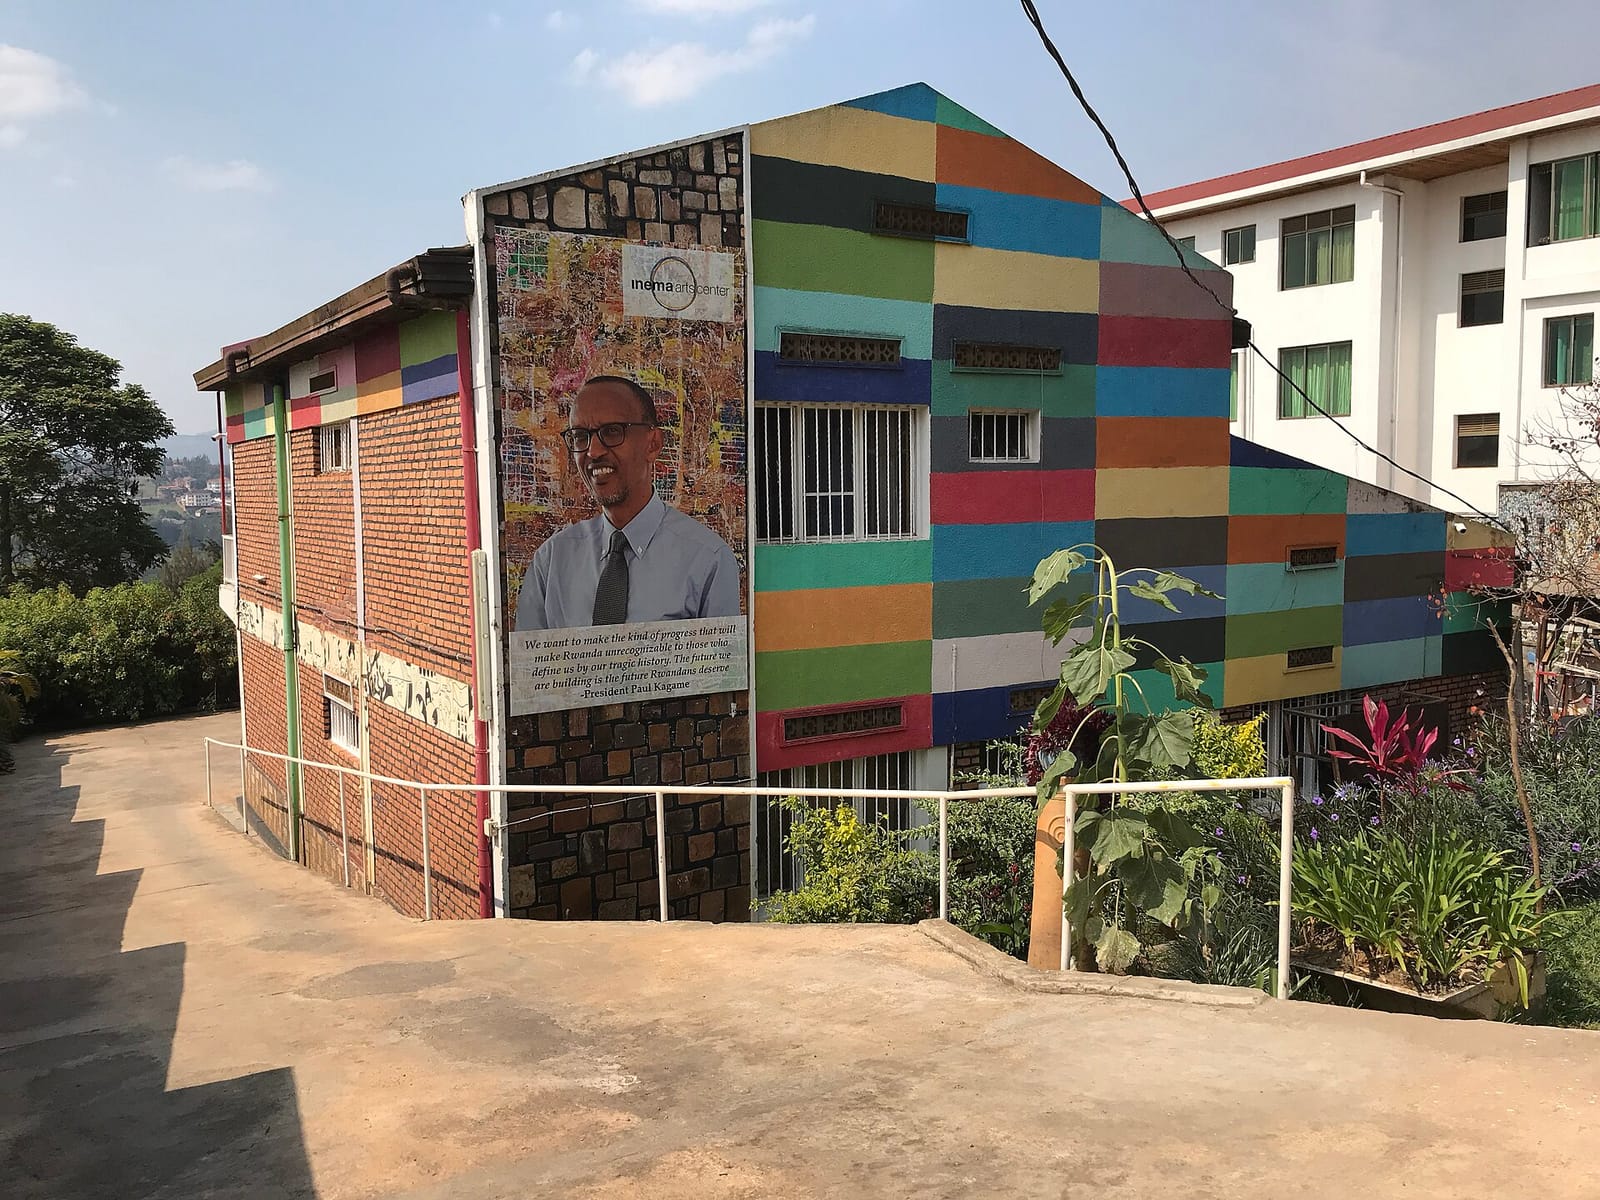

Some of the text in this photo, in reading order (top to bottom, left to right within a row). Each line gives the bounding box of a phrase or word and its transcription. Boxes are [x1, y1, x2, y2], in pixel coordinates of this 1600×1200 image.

[675, 282, 695, 294] arts
[696, 285, 730, 296] center
[525, 625, 736, 649] We want to make the kind of progress that will
[535, 638, 728, 662] make Rwanda unrecognizable to those who
[532, 666, 561, 678] define
[577, 664, 588, 675] by
[591, 663, 607, 671] our
[610, 660, 635, 671] tragic
[638, 656, 671, 667] history.
[674, 654, 690, 663] The
[690, 653, 717, 664] future
[535, 664, 729, 690] are building is the future Rwandans deserve
[580, 681, 690, 698] -President Paul Kagame
